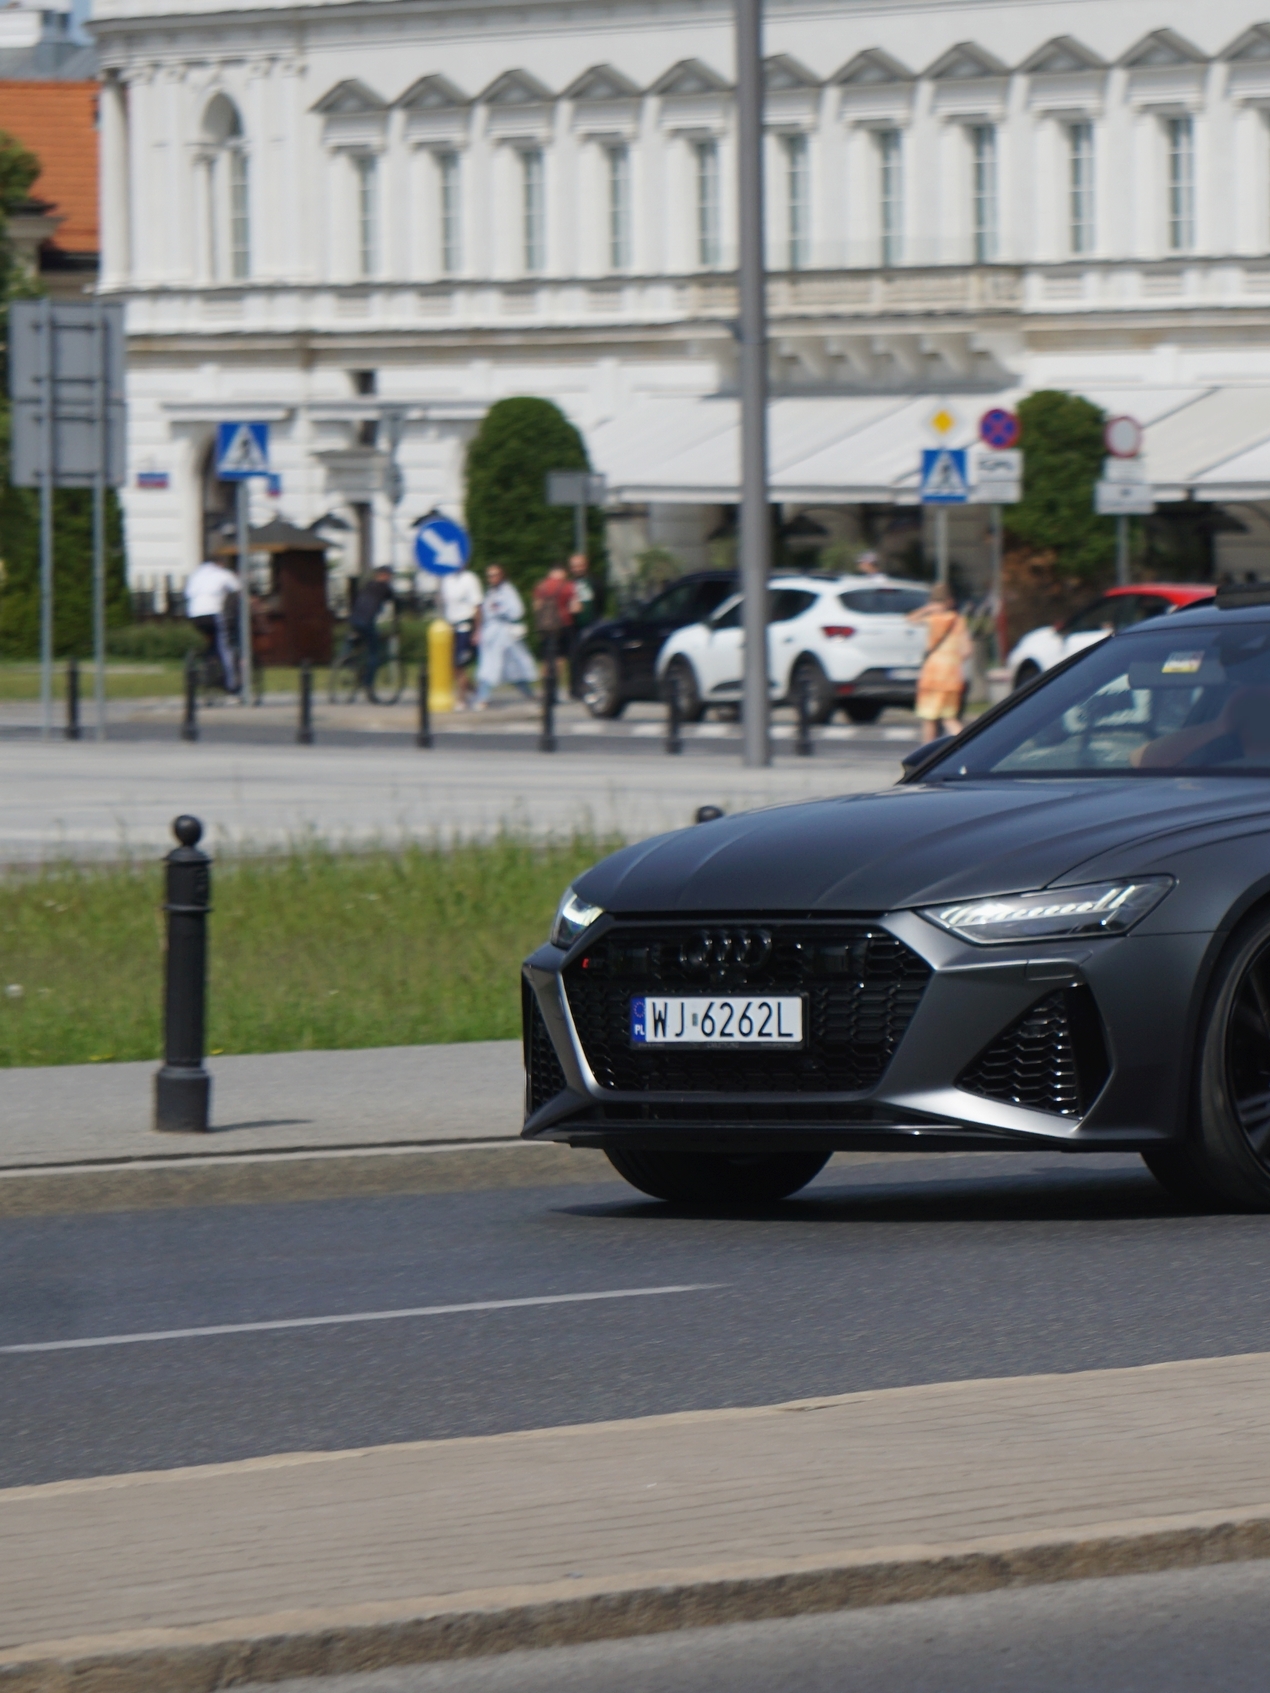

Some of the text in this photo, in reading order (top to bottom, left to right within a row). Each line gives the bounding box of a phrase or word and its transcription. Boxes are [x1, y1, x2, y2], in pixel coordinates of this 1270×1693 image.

[634, 1023, 646, 1036] PL
[652, 1001, 794, 1038] WJ 6262L
